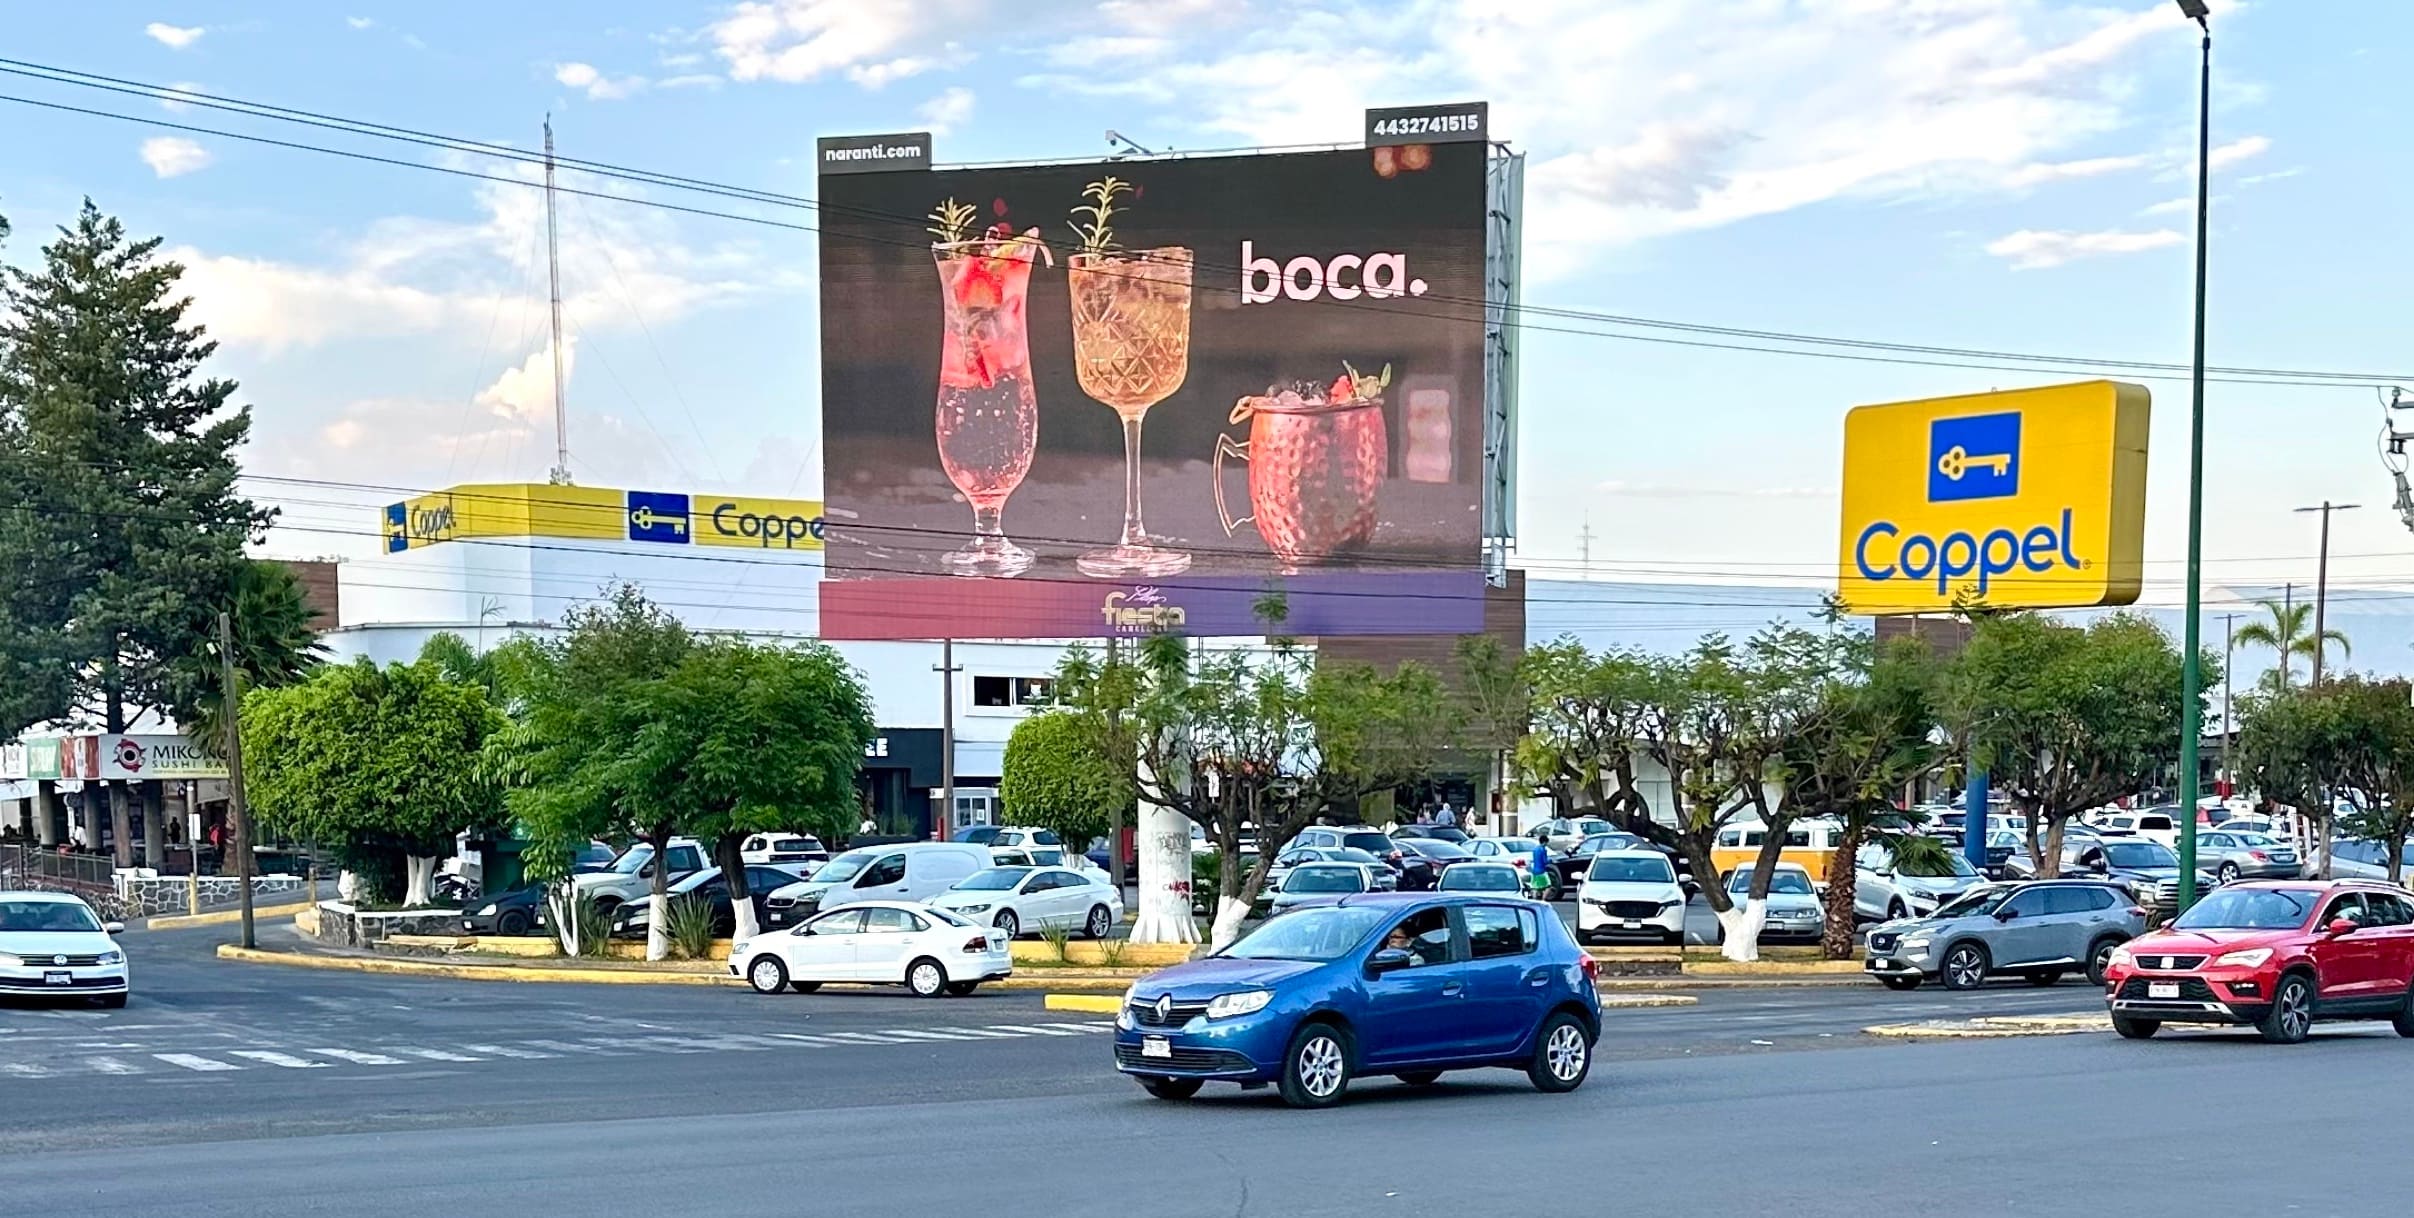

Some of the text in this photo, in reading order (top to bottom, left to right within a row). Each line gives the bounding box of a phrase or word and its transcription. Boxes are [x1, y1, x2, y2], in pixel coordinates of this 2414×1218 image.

[1373, 114, 1479, 136] 4432741515
[825, 143, 921, 161] naranti.com
[1241, 240, 1429, 305] boca.
[411, 504, 457, 543] Coppel
[712, 502, 825, 549] Coppe
[1856, 507, 2081, 596] Coppel
[1101, 591, 1186, 626] fiesta
[152, 760, 196, 769] SUSHI
